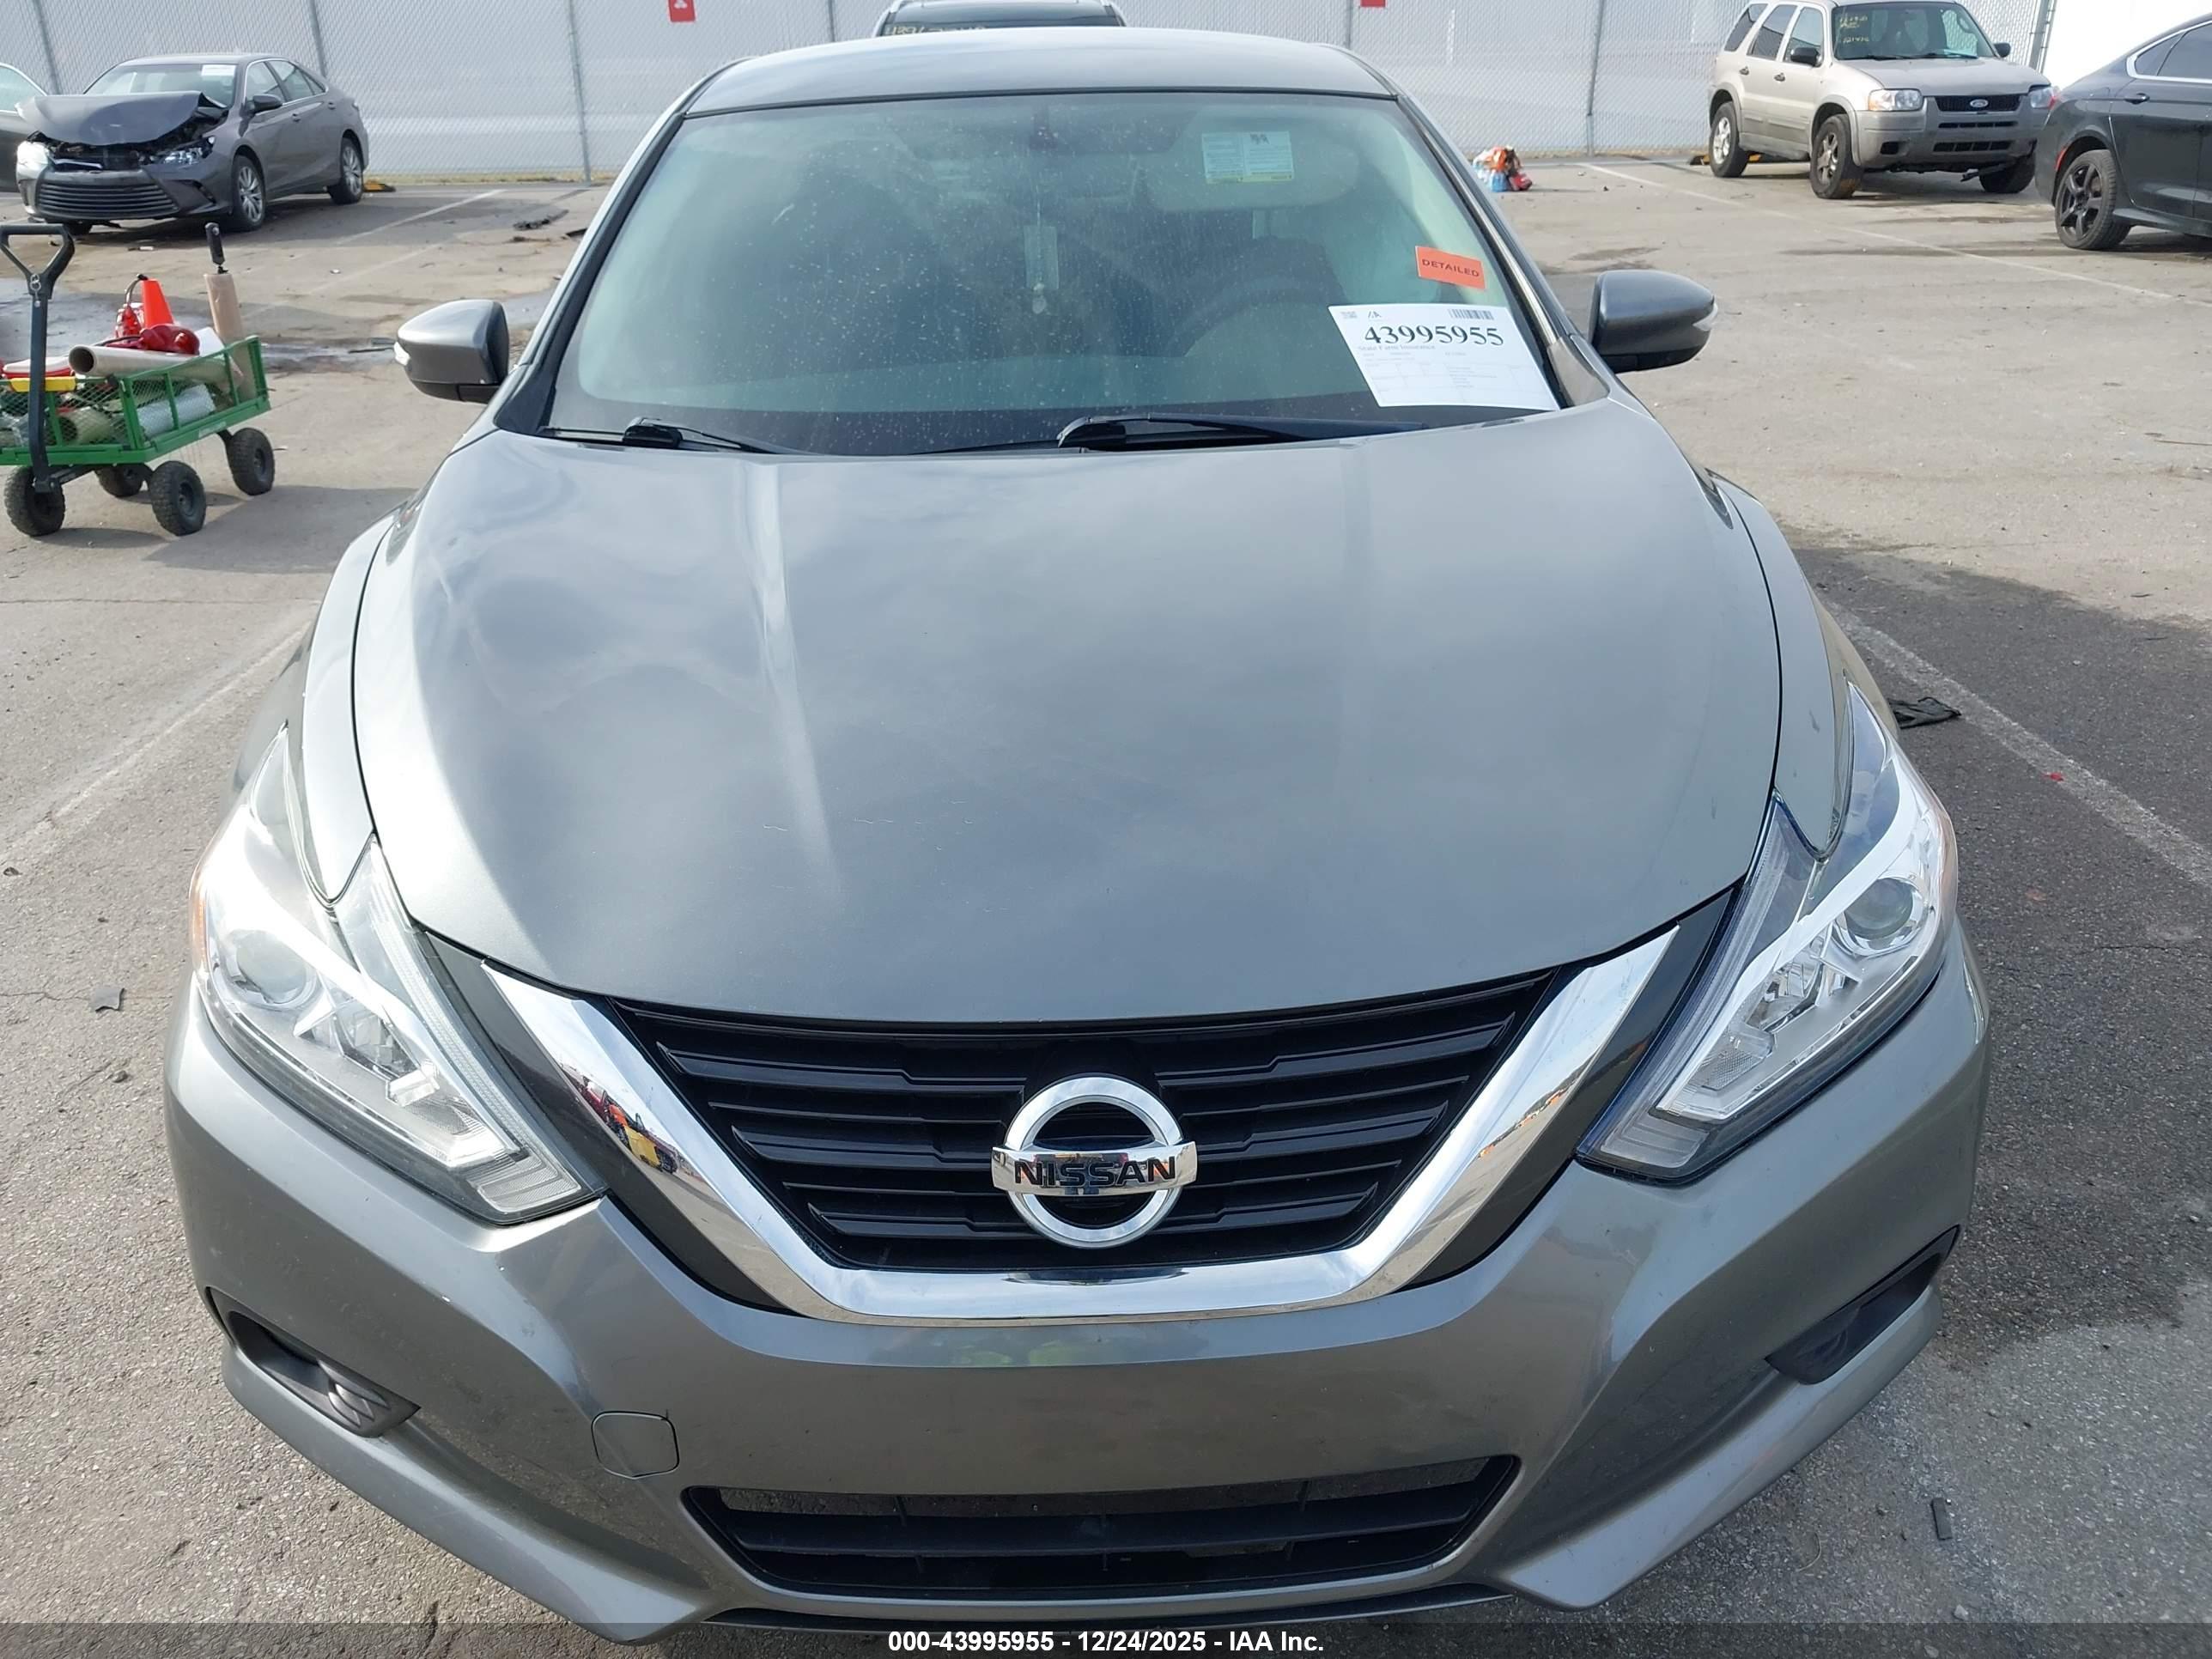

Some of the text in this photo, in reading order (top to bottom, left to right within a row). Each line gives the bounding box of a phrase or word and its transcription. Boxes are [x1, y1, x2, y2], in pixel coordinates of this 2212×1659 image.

[1421, 258, 1480, 277] DETAILED
[1364, 325, 1504, 346] 43995955
[1015, 1156, 1176, 1186] NISSAN
